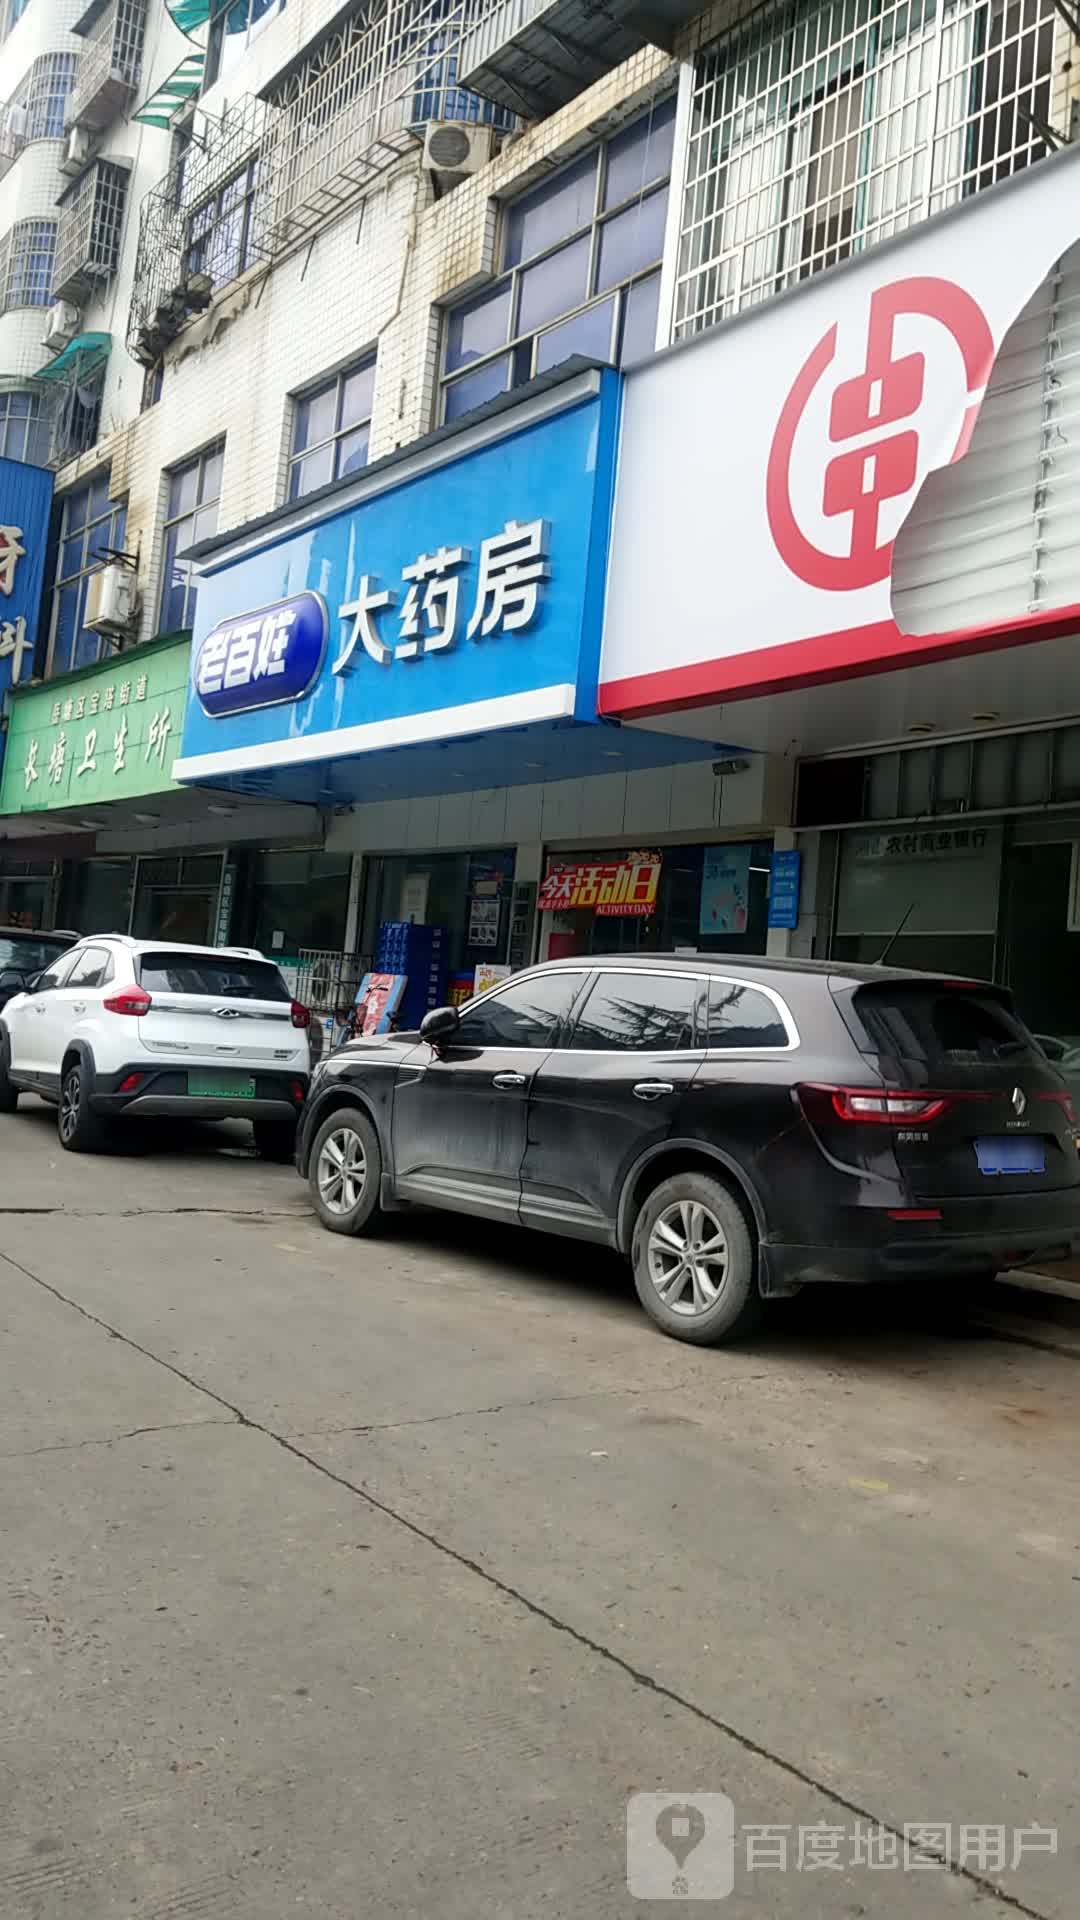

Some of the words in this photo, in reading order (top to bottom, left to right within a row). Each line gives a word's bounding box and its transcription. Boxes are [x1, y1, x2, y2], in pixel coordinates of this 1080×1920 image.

[198, 609, 297, 694] 老百姓
[332, 518, 553, 676] 大药房
